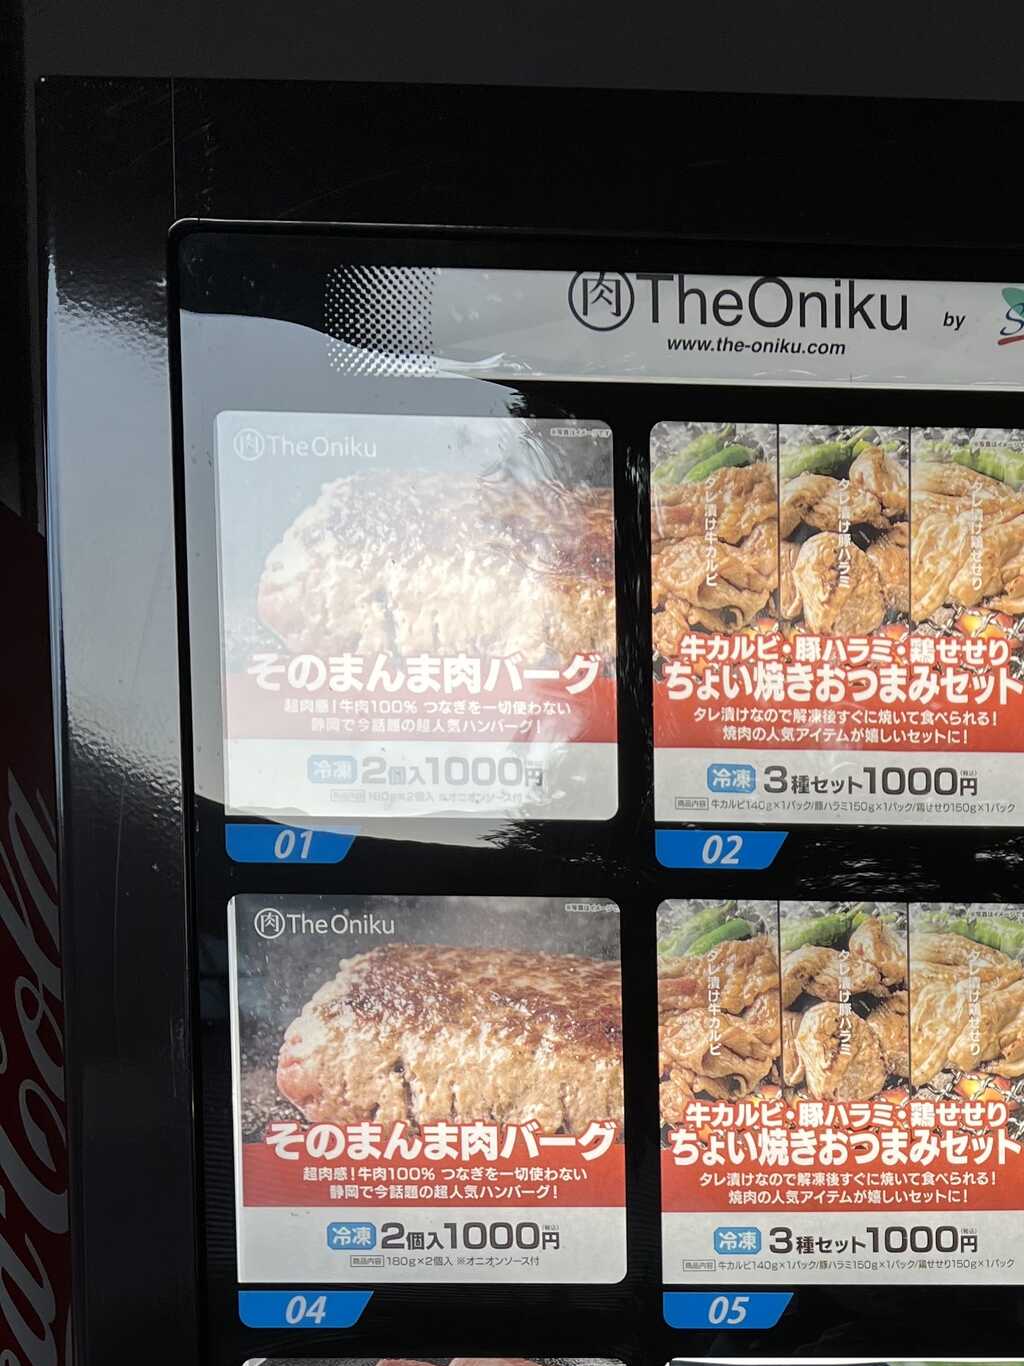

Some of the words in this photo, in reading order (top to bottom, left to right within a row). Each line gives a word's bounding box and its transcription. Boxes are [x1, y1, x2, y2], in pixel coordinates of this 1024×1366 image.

[943, 311, 965, 329] by
[666, 338, 846, 355] www.the-oniku.com
[681, 636, 1008, 665] 牛カルビ・豚ハラミ・鶏せせり
[247, 652, 601, 694] そのまんま肉バーグ
[665, 664, 1023, 705] ちょい焼きおつまみセット
[423, 701, 571, 715] つなぎを一切使わない
[694, 707, 997, 726] タレ漬けなので解凍後すぐに焼いて食べられる!
[723, 728, 968, 744] 焼肉の人気アイテムが嬉しいセットに!
[712, 768, 751, 786] 冷凍
[274, 831, 312, 859] 01
[702, 836, 742, 864] 02
[686, 1102, 1007, 1128] 牛カルビ・豚ハラミ・鶏せせり
[266, 1121, 617, 1161] そのまんま肉バーグ
[671, 1128, 1022, 1165] ちょい焼きおつまみセット
[442, 1168, 587, 1181] つなぎを一切使わない
[700, 1171, 996, 1186] タレ漬けなので解凍後すぐに焼いて食べられる!
[330, 1185, 558, 1199] 静岡で今話題の超人気ハンバーグ!
[729, 1189, 968, 1205] 焼肉の人気アイテムが嬉しいセットに!
[332, 1226, 371, 1245] 冷凍
[381, 1222, 560, 1250] 2個入1000円
[719, 1232, 757, 1251] 冷凍
[286, 1296, 326, 1324] 04
[708, 1297, 749, 1324] 05
